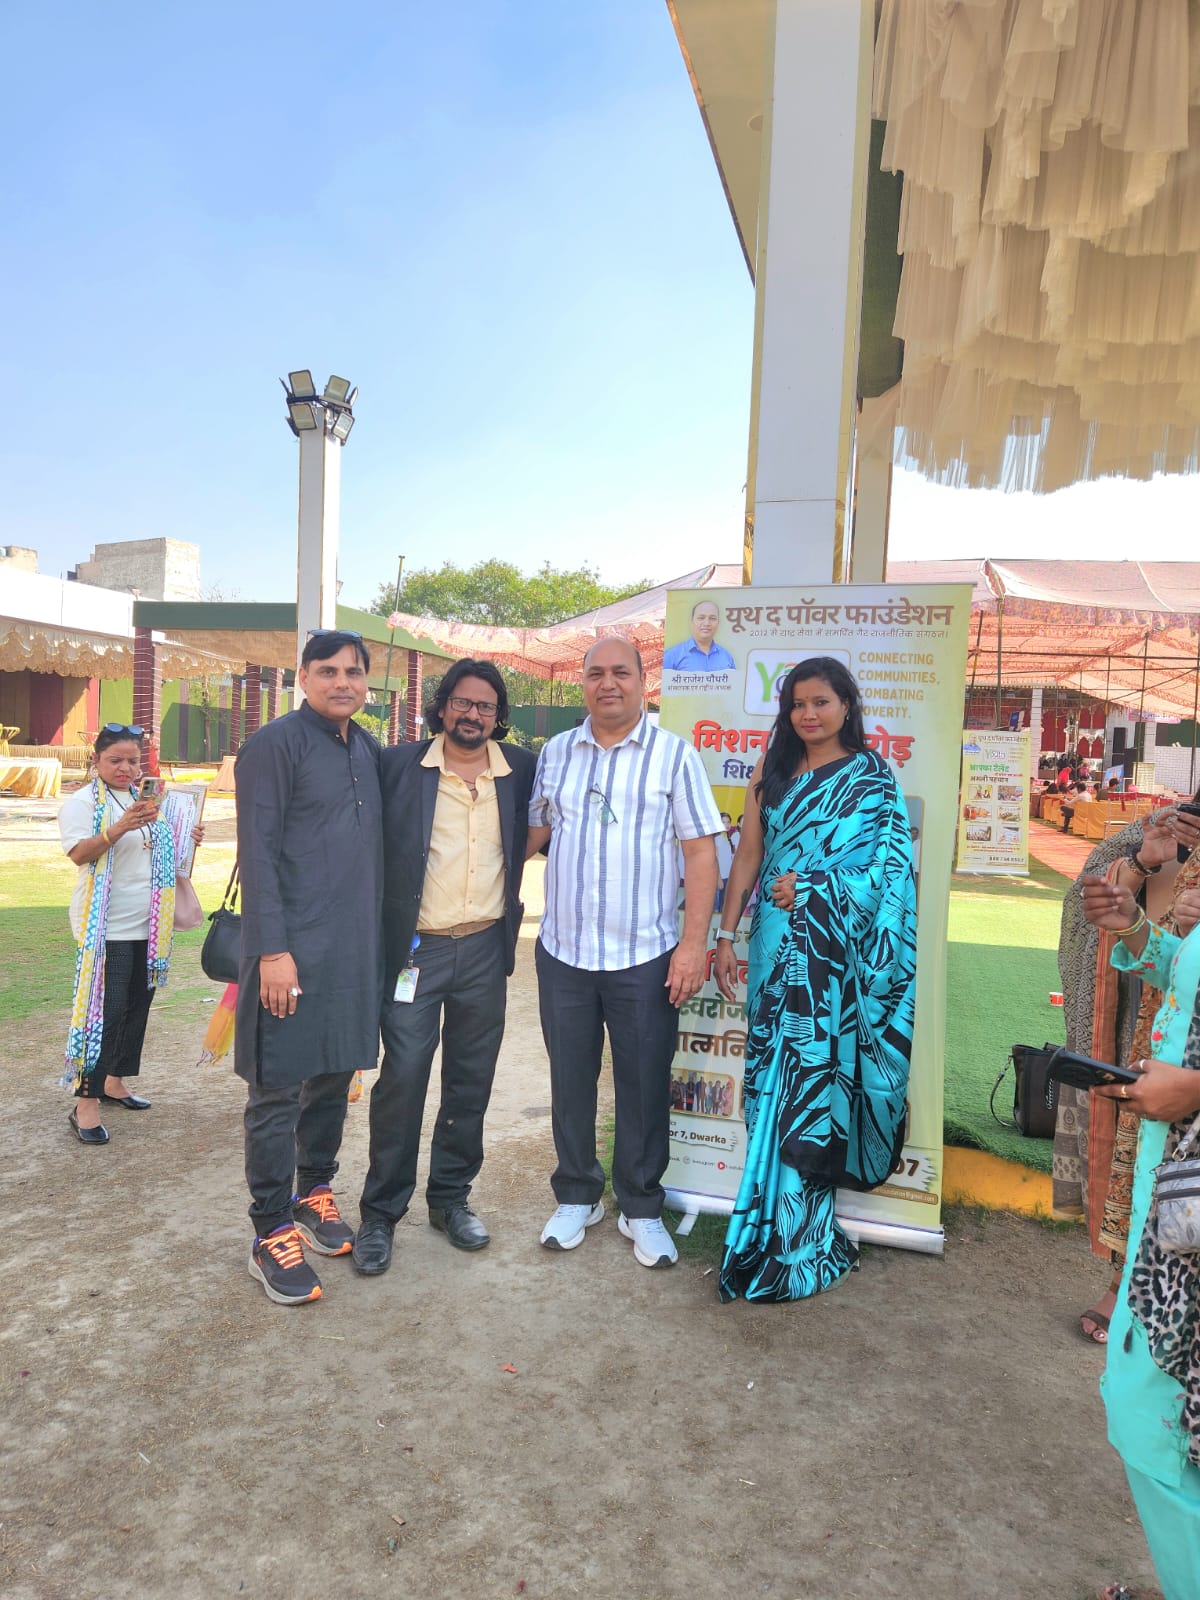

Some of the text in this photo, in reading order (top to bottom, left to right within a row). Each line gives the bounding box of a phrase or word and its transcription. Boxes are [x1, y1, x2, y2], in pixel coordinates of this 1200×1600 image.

[725, 597, 955, 633] यूथ द पॉवर फाउंडेशन
[858, 651, 934, 666] CONNECTING
[671, 674, 681, 684] श्री
[683, 674, 704, 684] राजेश
[857, 670, 941, 685] COMMUNITIES,
[858, 687, 925, 702] COMBATING
[691, 719, 915, 768] मिशन रोड़
[679, 992, 747, 1022] स्वरोज
[690, 1132, 727, 1145] Dwarka
